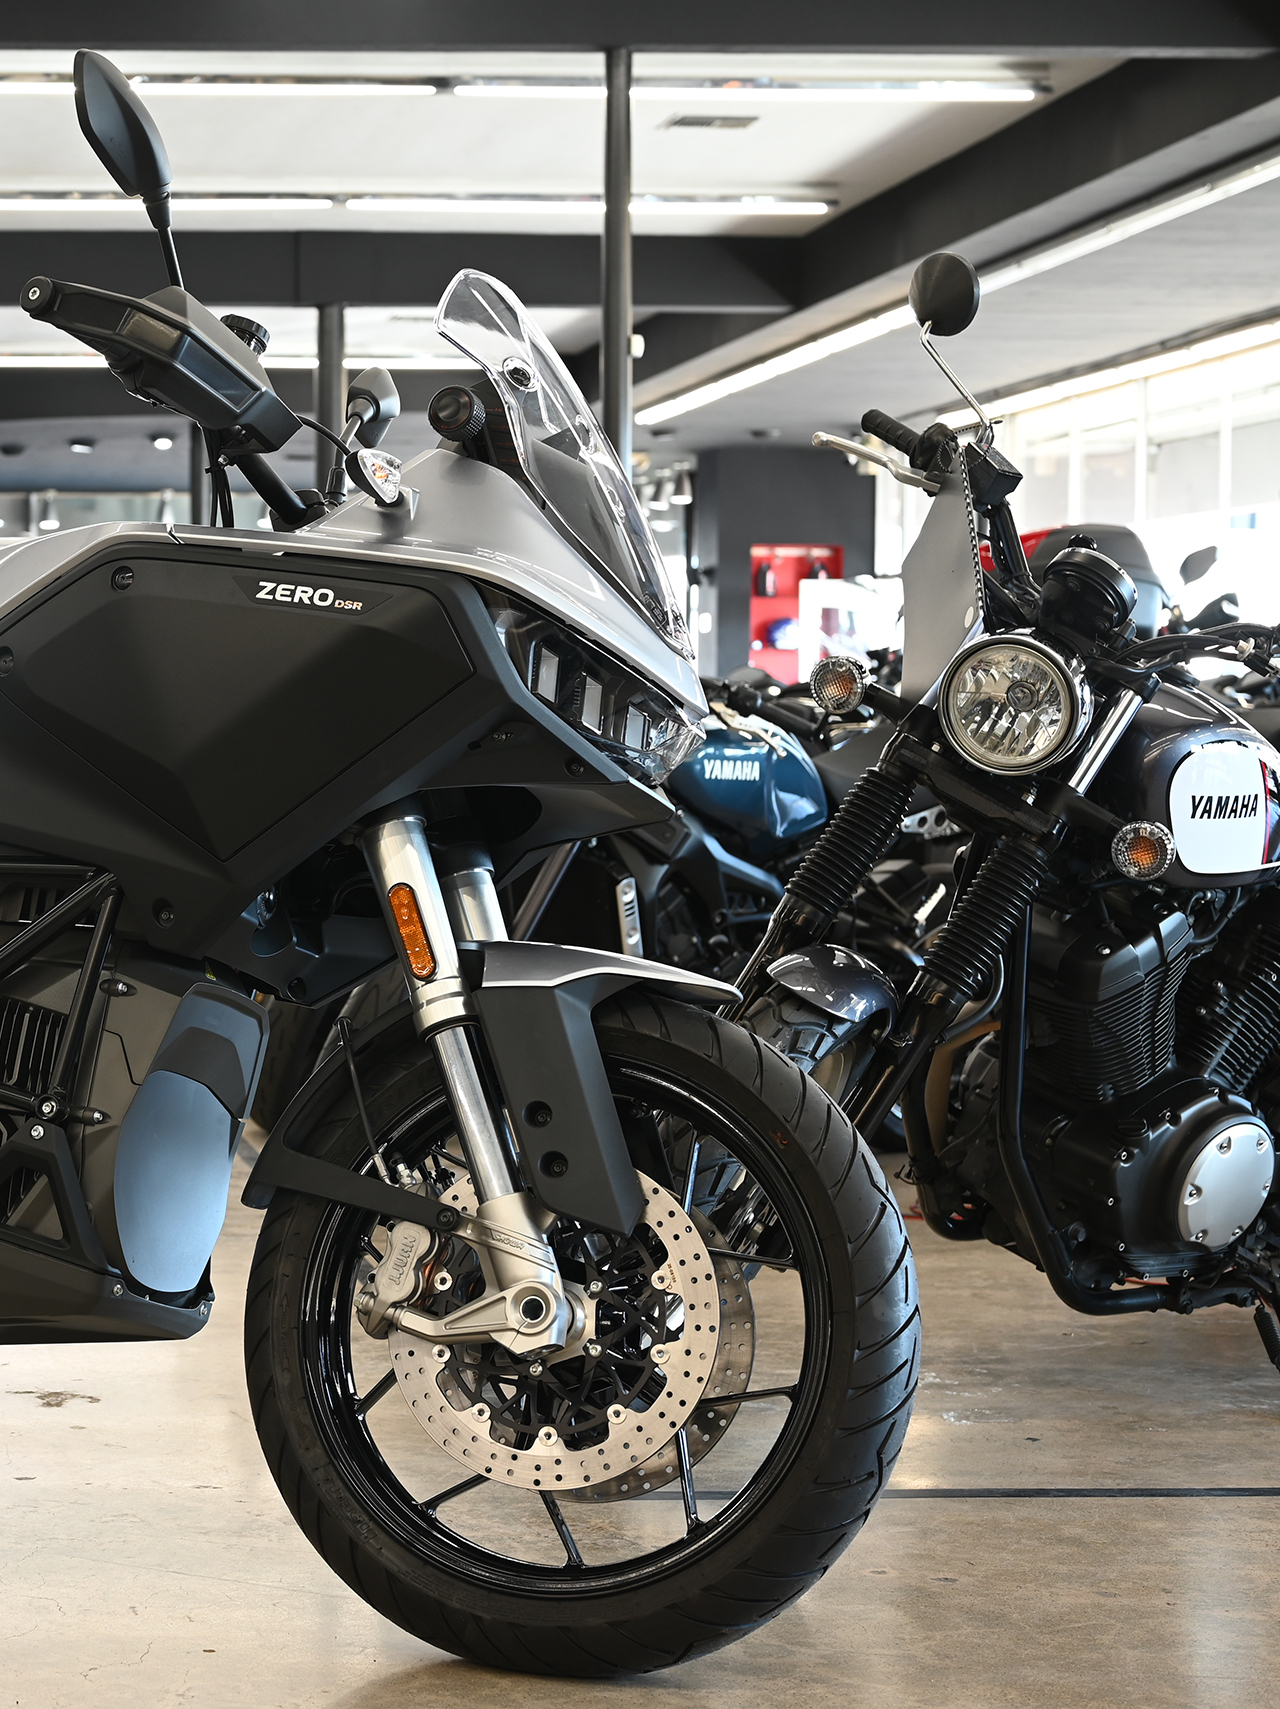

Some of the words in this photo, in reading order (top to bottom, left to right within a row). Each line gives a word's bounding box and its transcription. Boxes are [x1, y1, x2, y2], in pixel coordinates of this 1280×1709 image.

[255, 581, 335, 606] ZERO
[334, 599, 363, 610] DSR
[703, 759, 760, 781] YAMAHA
[1190, 793, 1259, 819] YAMAHA
[388, 1233, 417, 1286] J.JUAN
